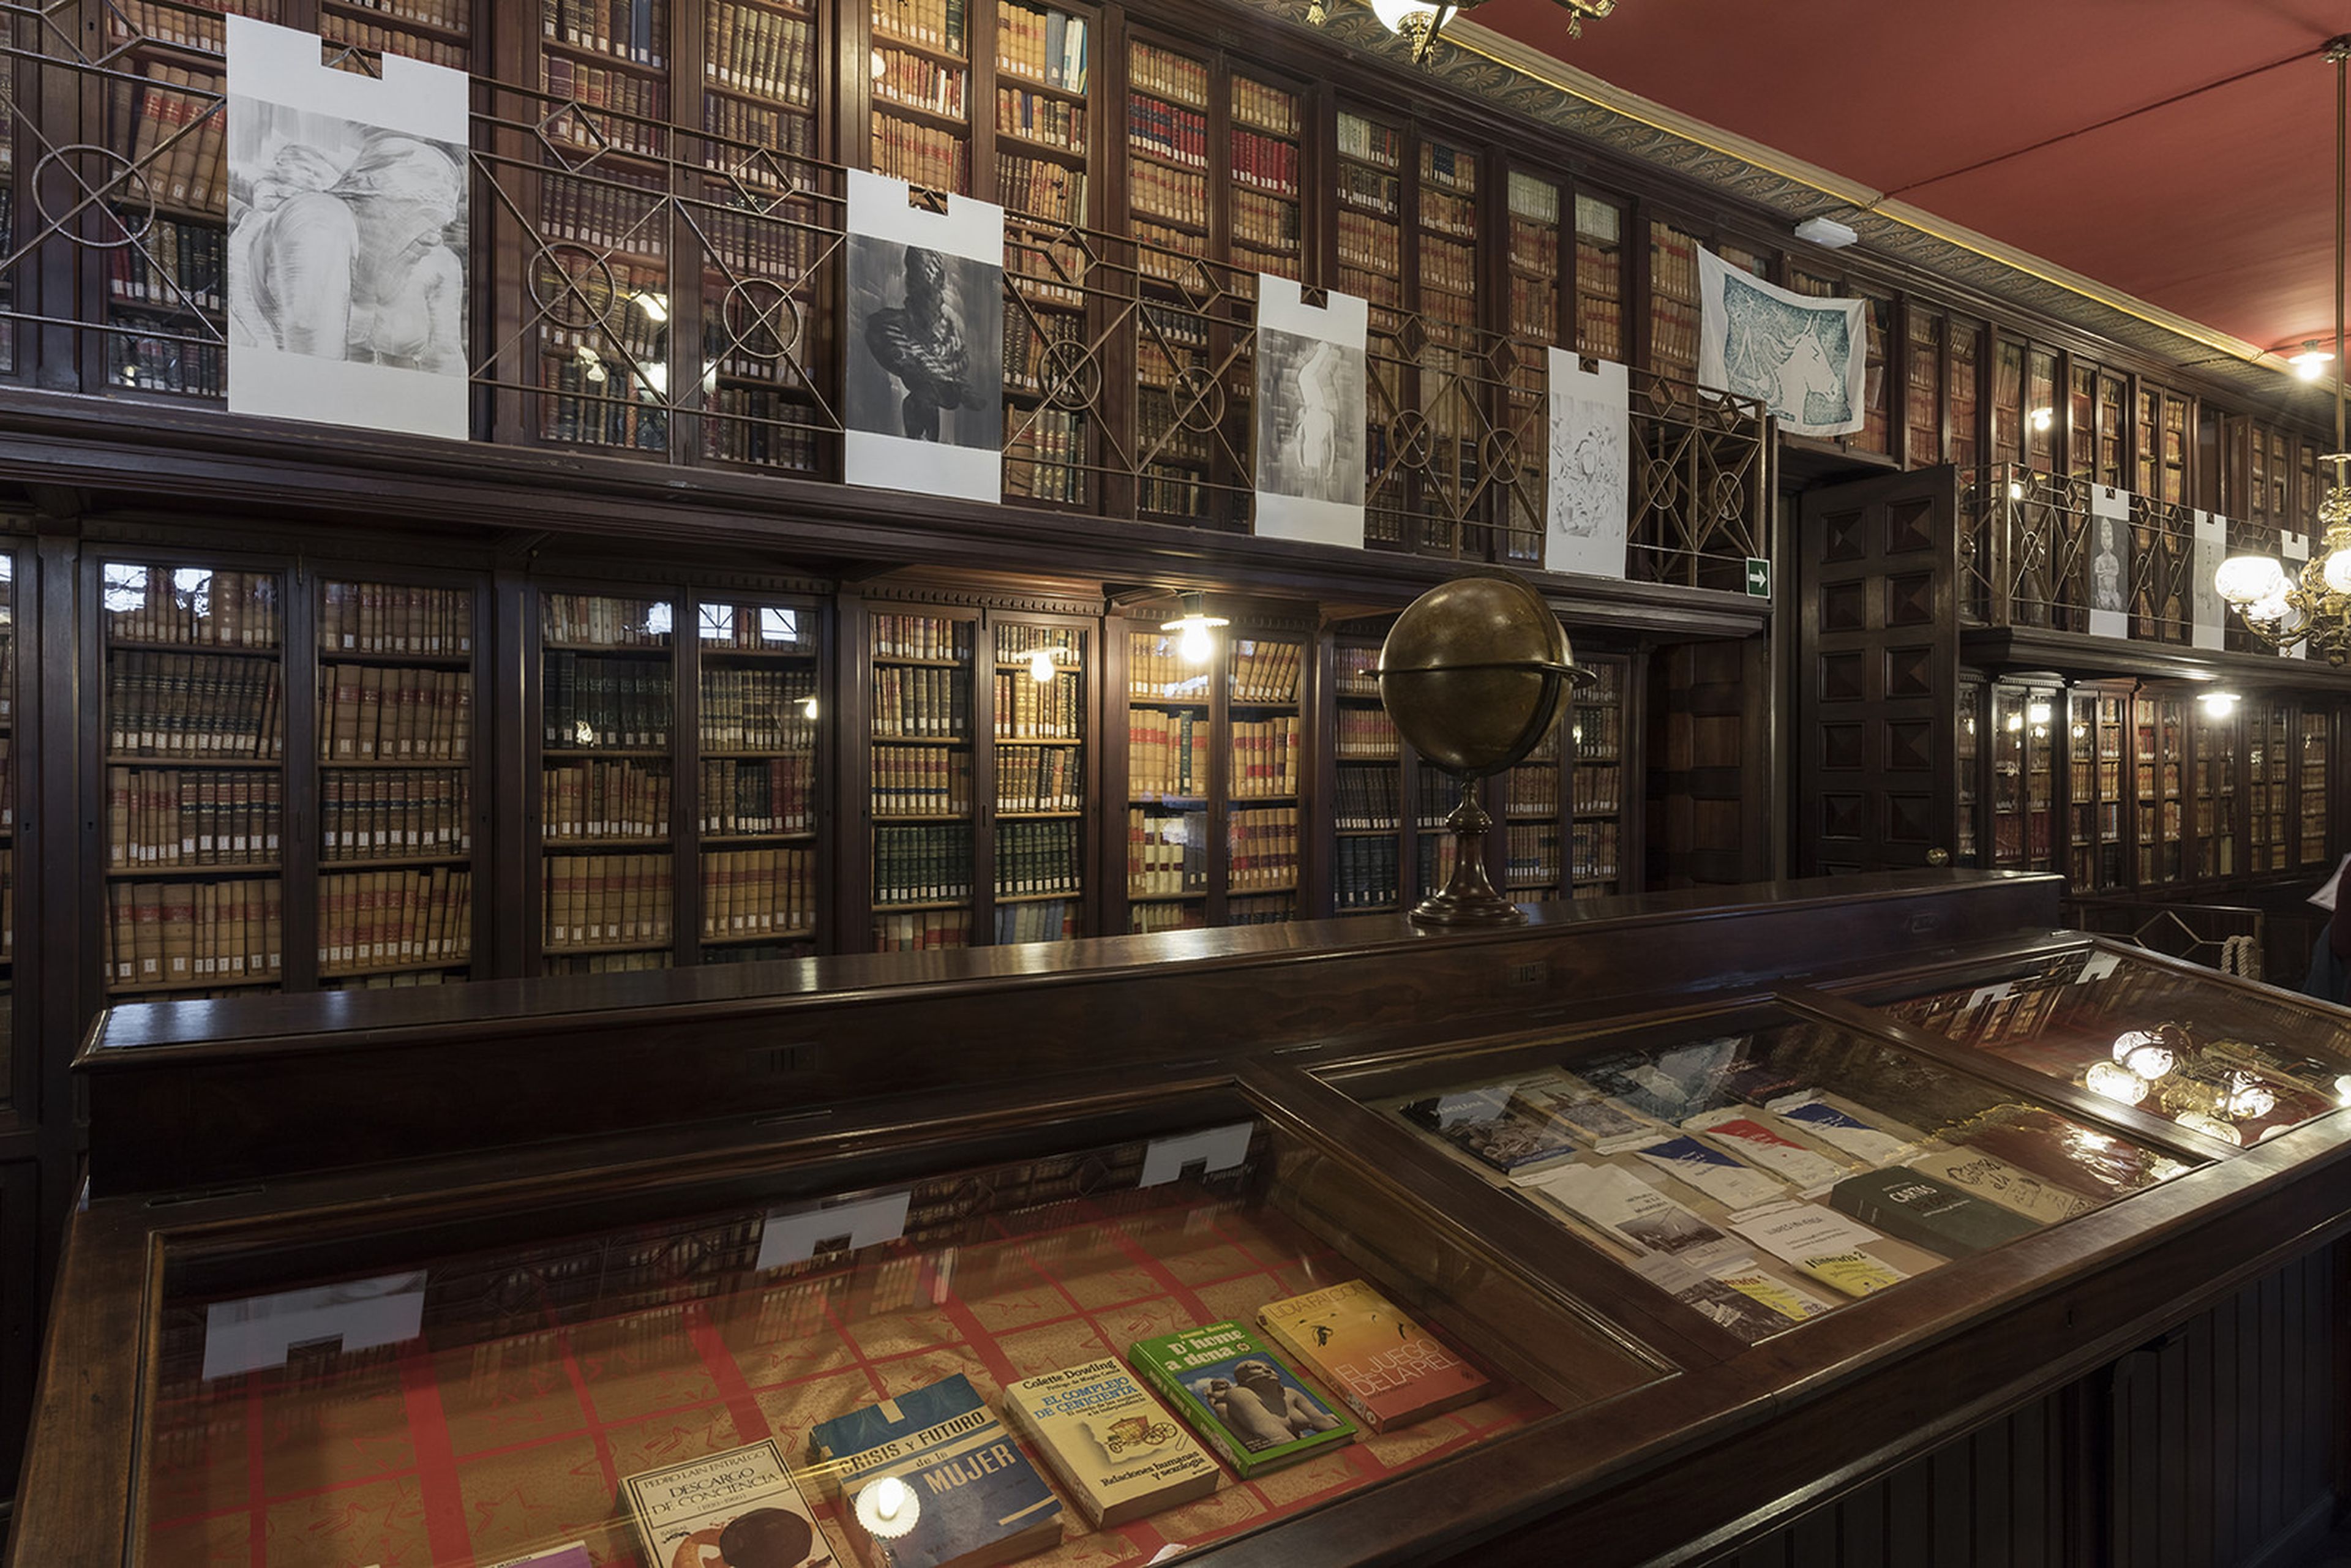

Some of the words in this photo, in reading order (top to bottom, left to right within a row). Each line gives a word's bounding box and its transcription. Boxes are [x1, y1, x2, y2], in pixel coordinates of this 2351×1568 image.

[1022, 1371, 1063, 1390] Colette
[1063, 1359, 1117, 1380] Dowling
[1163, 1358, 1183, 1371] a
[1183, 1345, 1236, 1367] dona
[1335, 1362, 1374, 1383] EL
[1369, 1338, 1440, 1375] JUEGO
[1350, 1371, 1390, 1397] DE
[1381, 1360, 1413, 1386] LA
[1409, 1349, 1461, 1376] PIEL
[1033, 1408, 1056, 1420] DE
[1055, 1386, 1138, 1414] CENICIENTA
[1041, 1393, 1061, 1407] EL
[1060, 1376, 1131, 1402] COMPLEJO
[838, 1444, 901, 1474] CRISIS
[918, 1411, 986, 1447] FUTURO
[643, 1472, 680, 1490] PEDRO
[708, 1450, 767, 1471] ENTRALGO
[916, 1457, 931, 1468] de
[923, 1442, 1017, 1495] MUJER
[1100, 1467, 1154, 1488] Relaciones
[1152, 1450, 1200, 1471] humanas
[651, 1502, 672, 1516] DE
[678, 1472, 780, 1508] CONCIENCIA
[669, 1467, 755, 1498] DESCARGO
